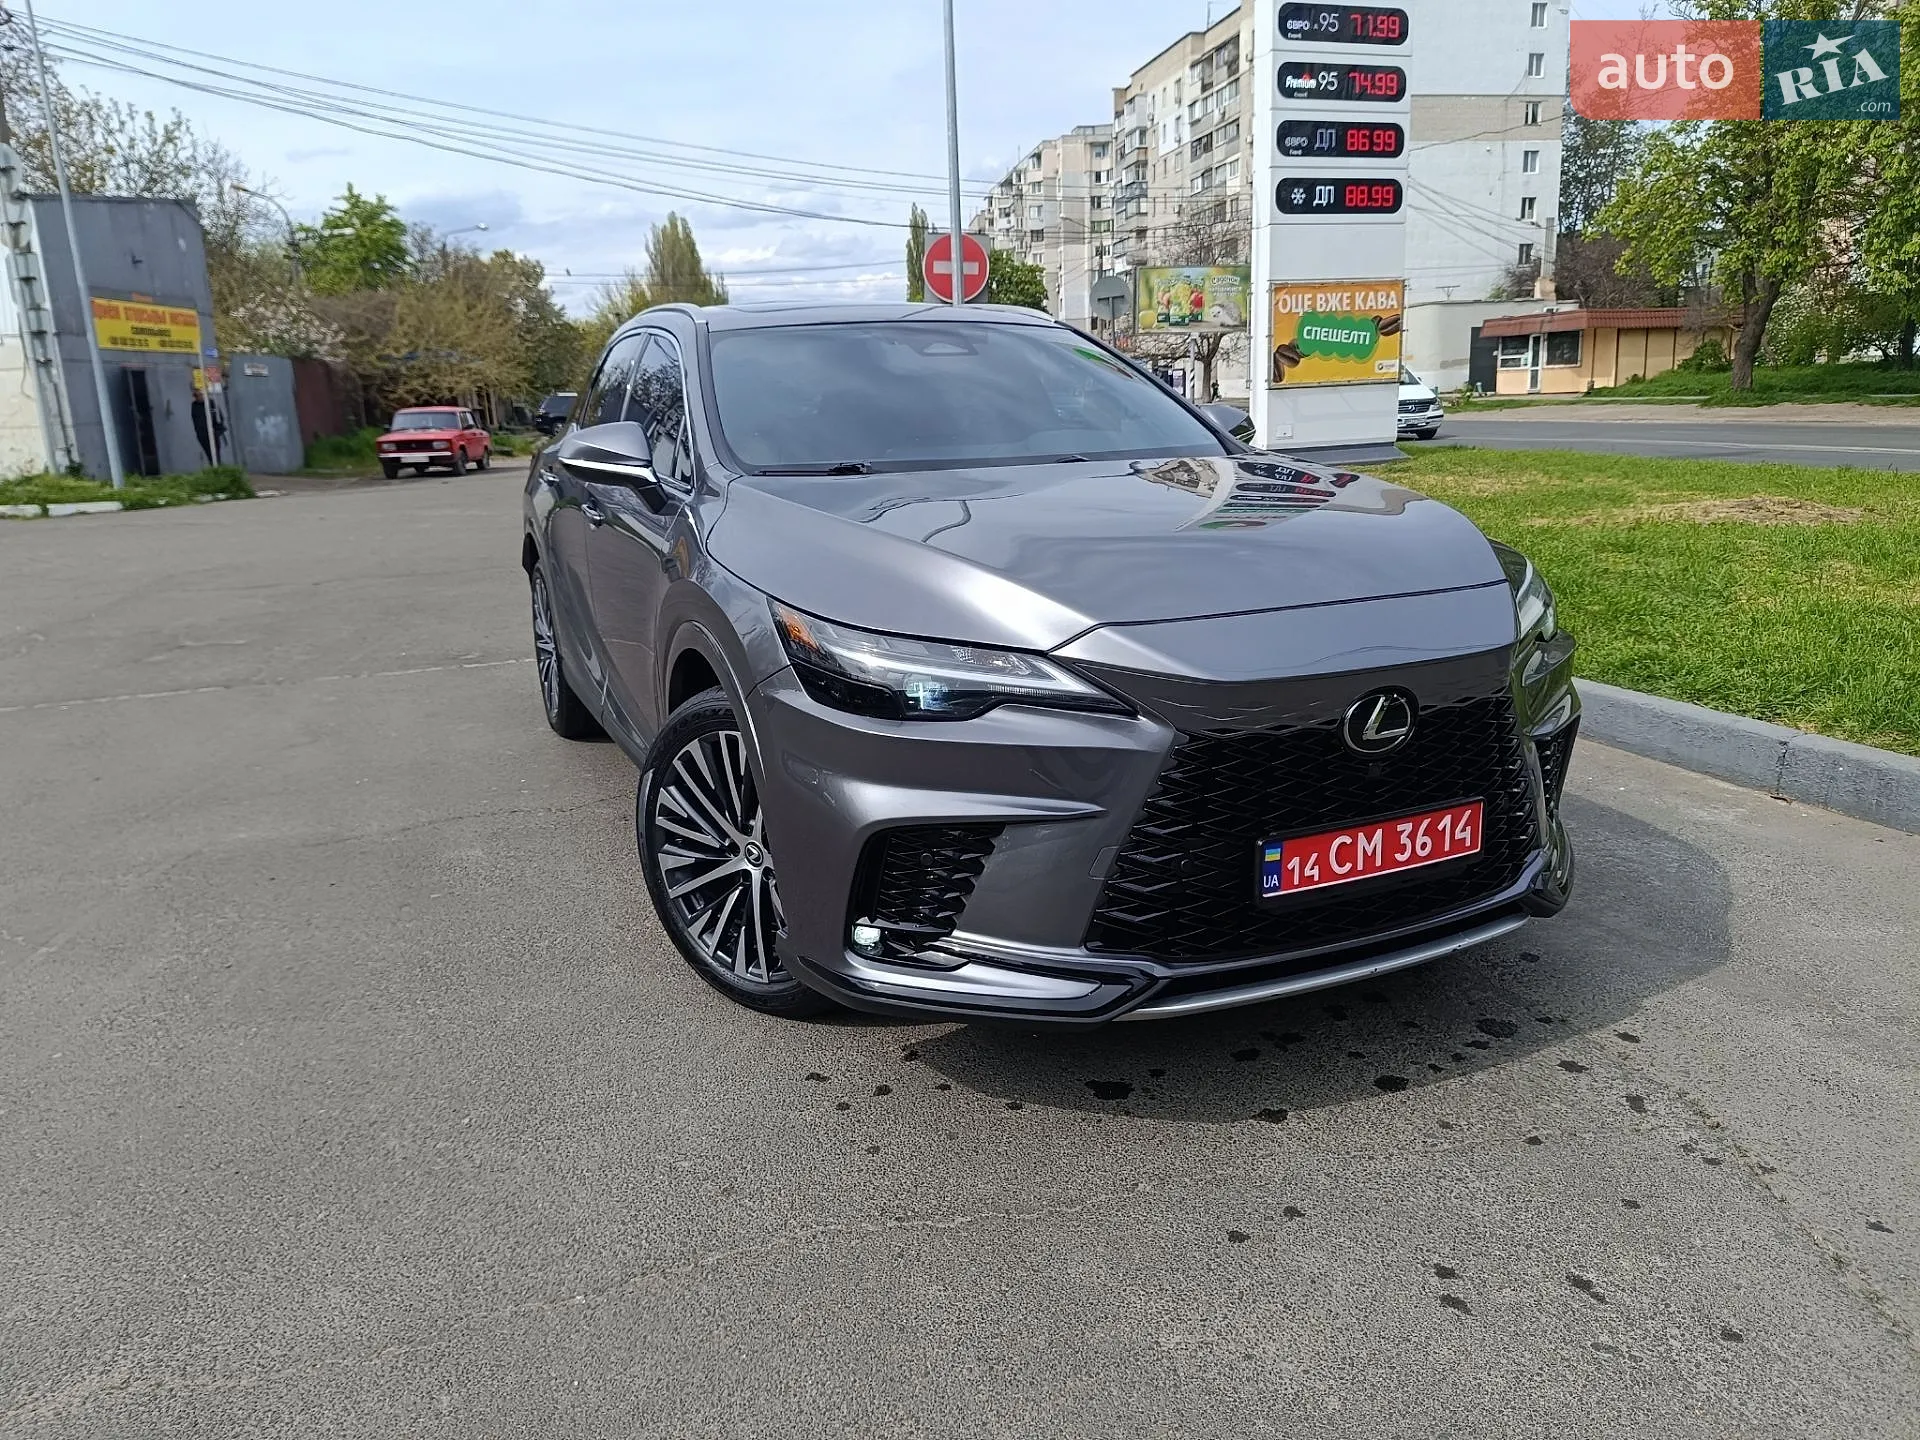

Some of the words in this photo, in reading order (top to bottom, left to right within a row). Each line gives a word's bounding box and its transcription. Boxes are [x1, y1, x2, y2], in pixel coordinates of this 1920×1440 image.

[1350, 14, 1400, 38] 71.99
[1318, 71, 1339, 91] 95
[1349, 71, 1399, 95] 74.99
[1314, 128, 1336, 151] ДП
[1313, 186, 1335, 207] ДП
[1345, 185, 1394, 207] 88.99
[1278, 292, 1313, 316] ОЦЕ
[1316, 292, 1352, 312] ВЖЕ
[1355, 290, 1398, 311] КАВА
[1303, 325, 1371, 345] СПЕШЕЛТІ
[1286, 852, 1319, 886] 14
[1329, 828, 1383, 875] CM
[1394, 809, 1473, 863] 3614
[1263, 874, 1279, 888] UA
